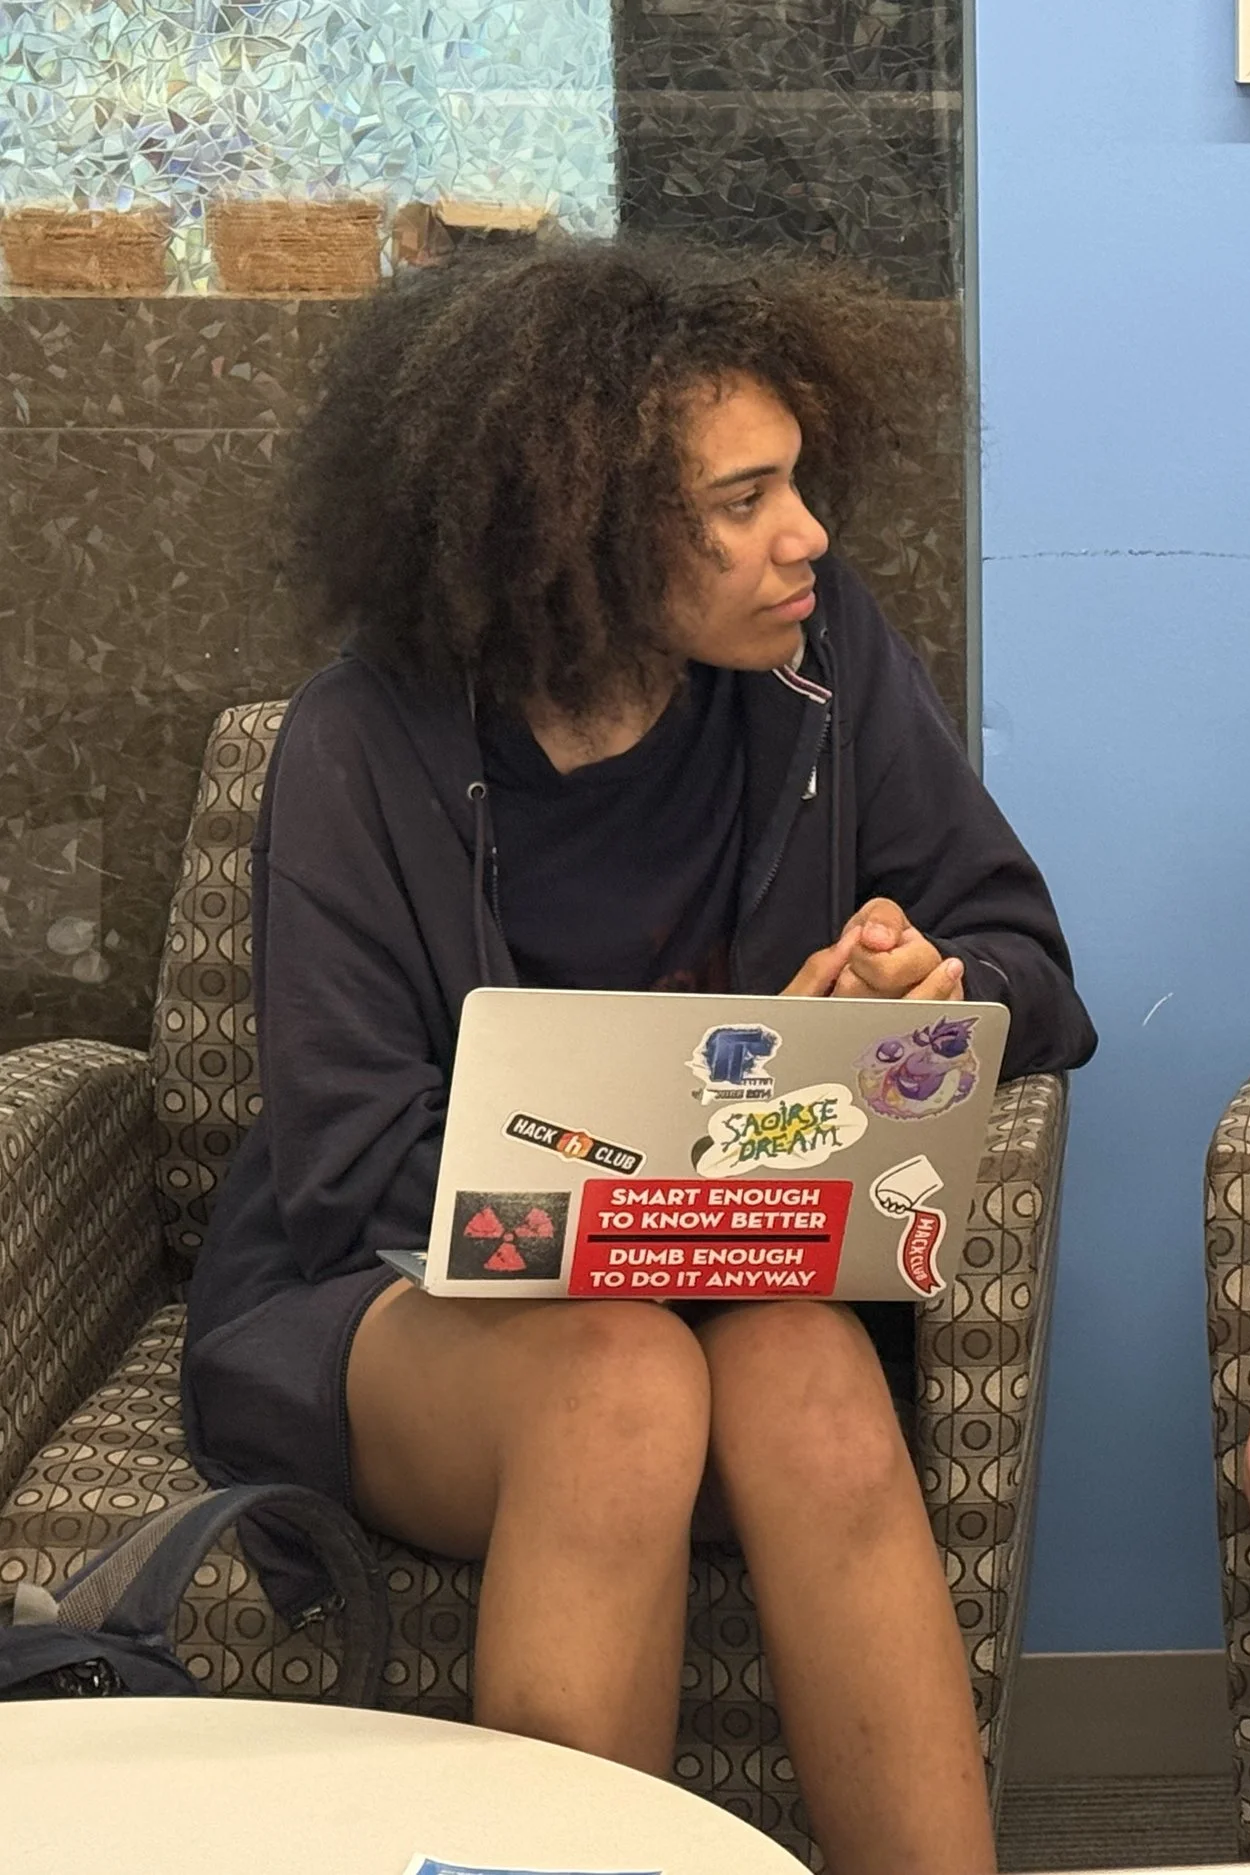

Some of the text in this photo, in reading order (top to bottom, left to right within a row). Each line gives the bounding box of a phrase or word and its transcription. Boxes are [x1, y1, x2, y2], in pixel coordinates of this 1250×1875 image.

[513, 1118, 558, 1145] HACK
[594, 1147, 637, 1171] CLUB
[729, 1125, 843, 1168] DREAM
[611, 1188, 821, 1206] SMART ENOUGH
[599, 1211, 827, 1229] TO KNOW BETTER
[609, 1248, 804, 1266] DUMB ENOUGH
[909, 1218, 936, 1281] HACK CLUB
[589, 1271, 817, 1288] TO DO IT ANYWAY
